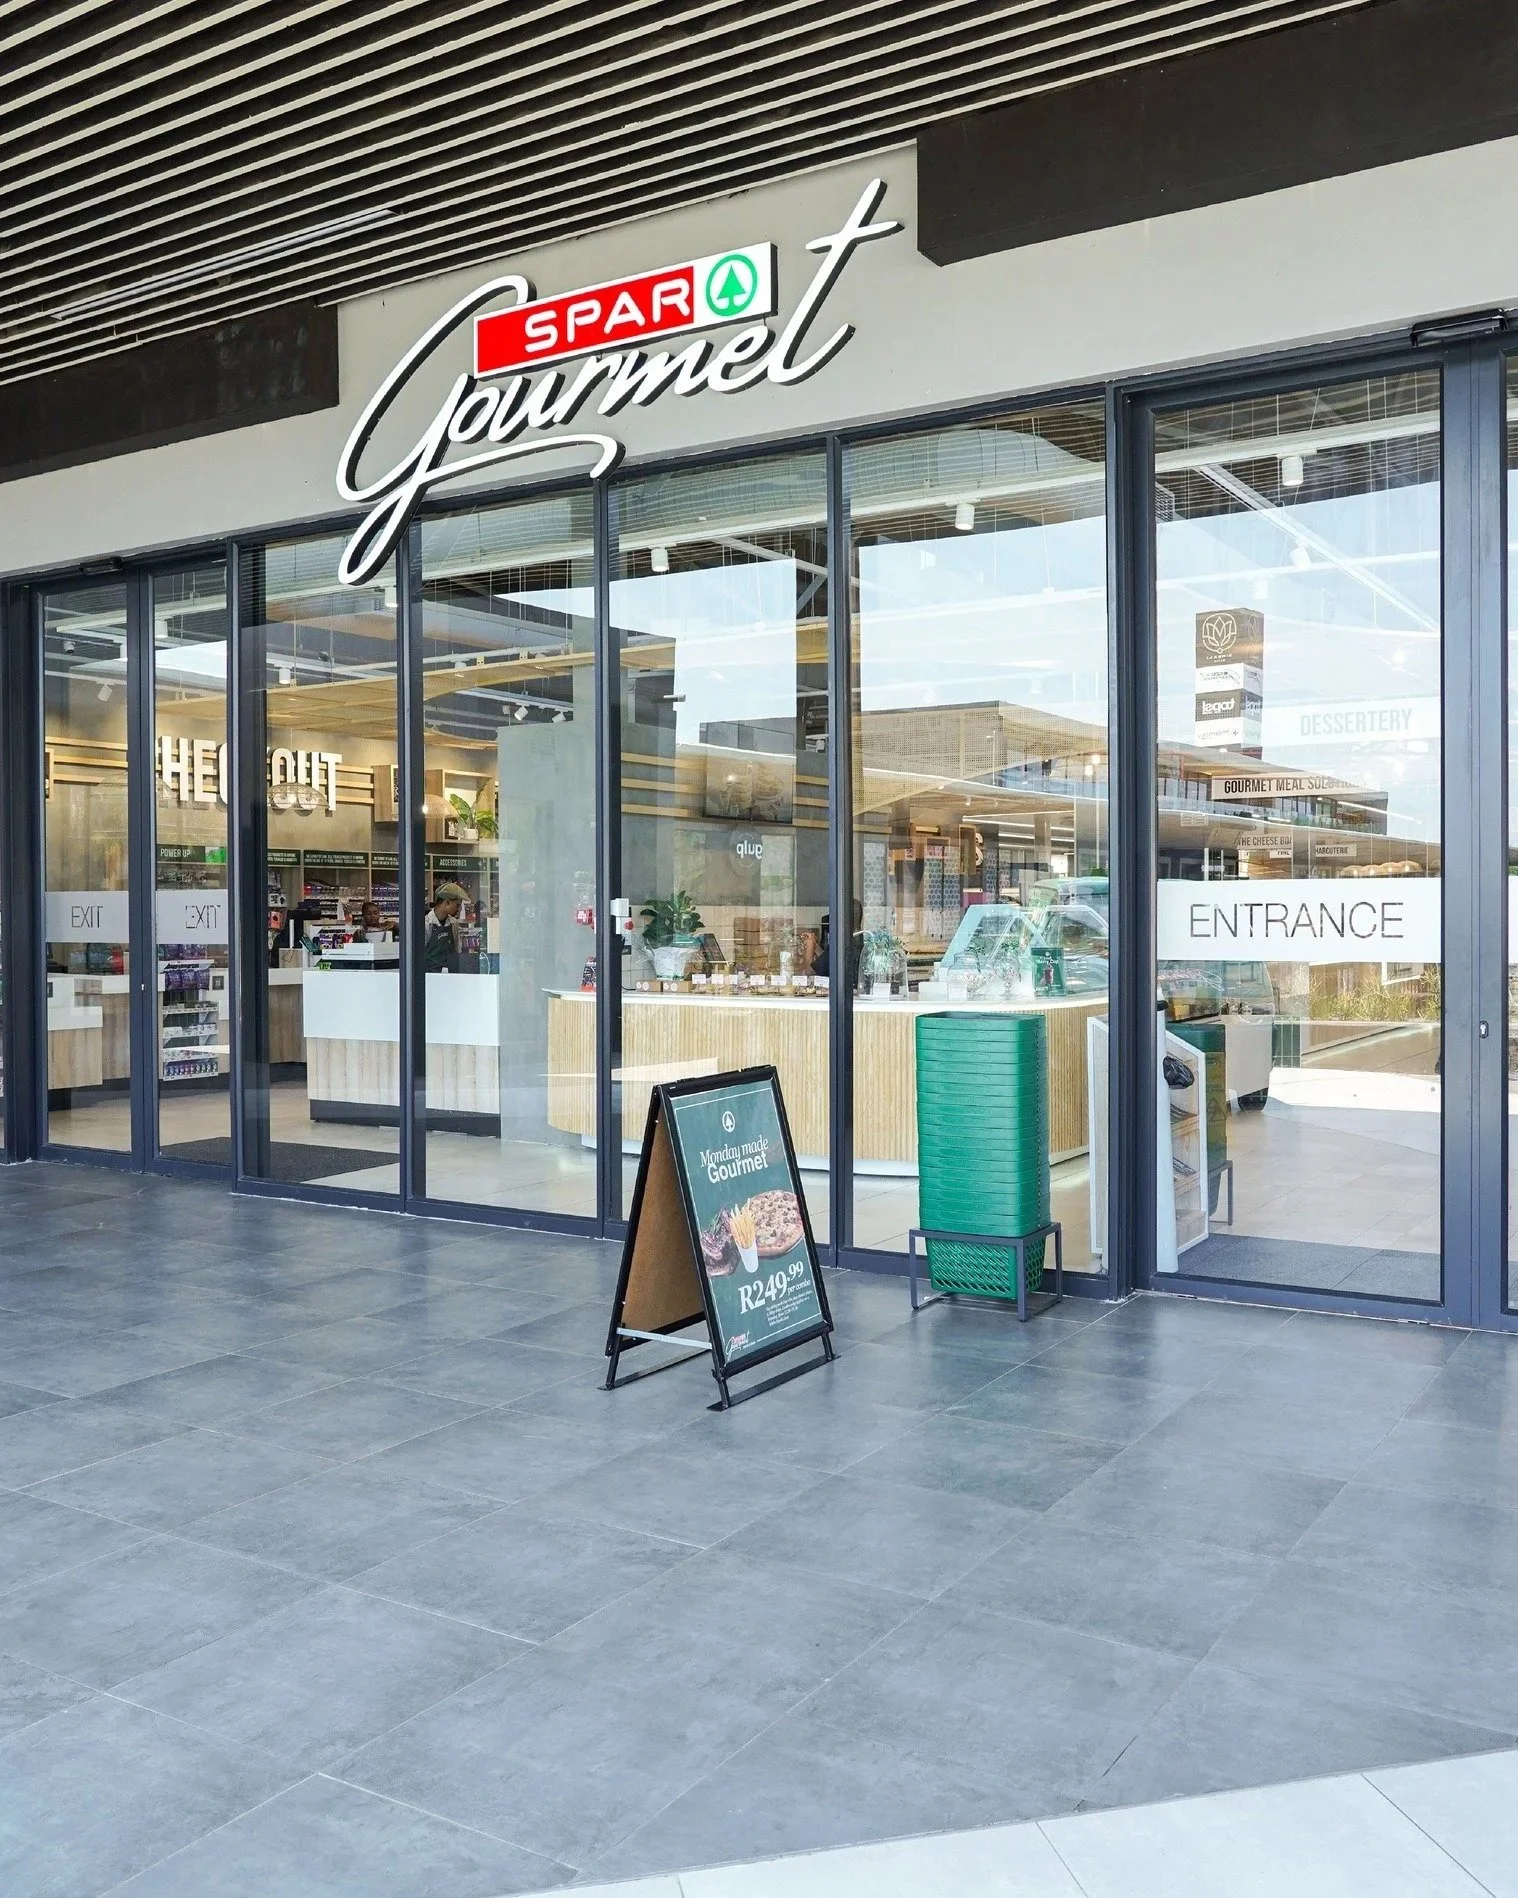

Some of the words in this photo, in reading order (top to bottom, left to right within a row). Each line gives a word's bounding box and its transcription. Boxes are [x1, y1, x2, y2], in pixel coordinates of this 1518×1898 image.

[524, 277, 691, 353] SPAR
[336, 178, 898, 586] Gourmet
[1300, 708, 1412, 737] DESSERTERY
[1224, 778, 1272, 794] GOURMET
[1275, 777, 1305, 792] MEAL
[160, 848, 181, 858] POWER
[183, 848, 191, 858] UP
[1252, 835, 1278, 847] CHEESE
[439, 859, 467, 867] ACCESSORIES
[72, 905, 103, 928] EXIT
[1190, 902, 1404, 939] ENTRANCE
[700, 1143, 741, 1168] Monday
[741, 1134, 769, 1156] made
[707, 1150, 769, 1184] Gourmet
[738, 1261, 804, 1315] R249.99
[787, 1285, 796, 1296] per
[795, 1279, 812, 1290] combo
